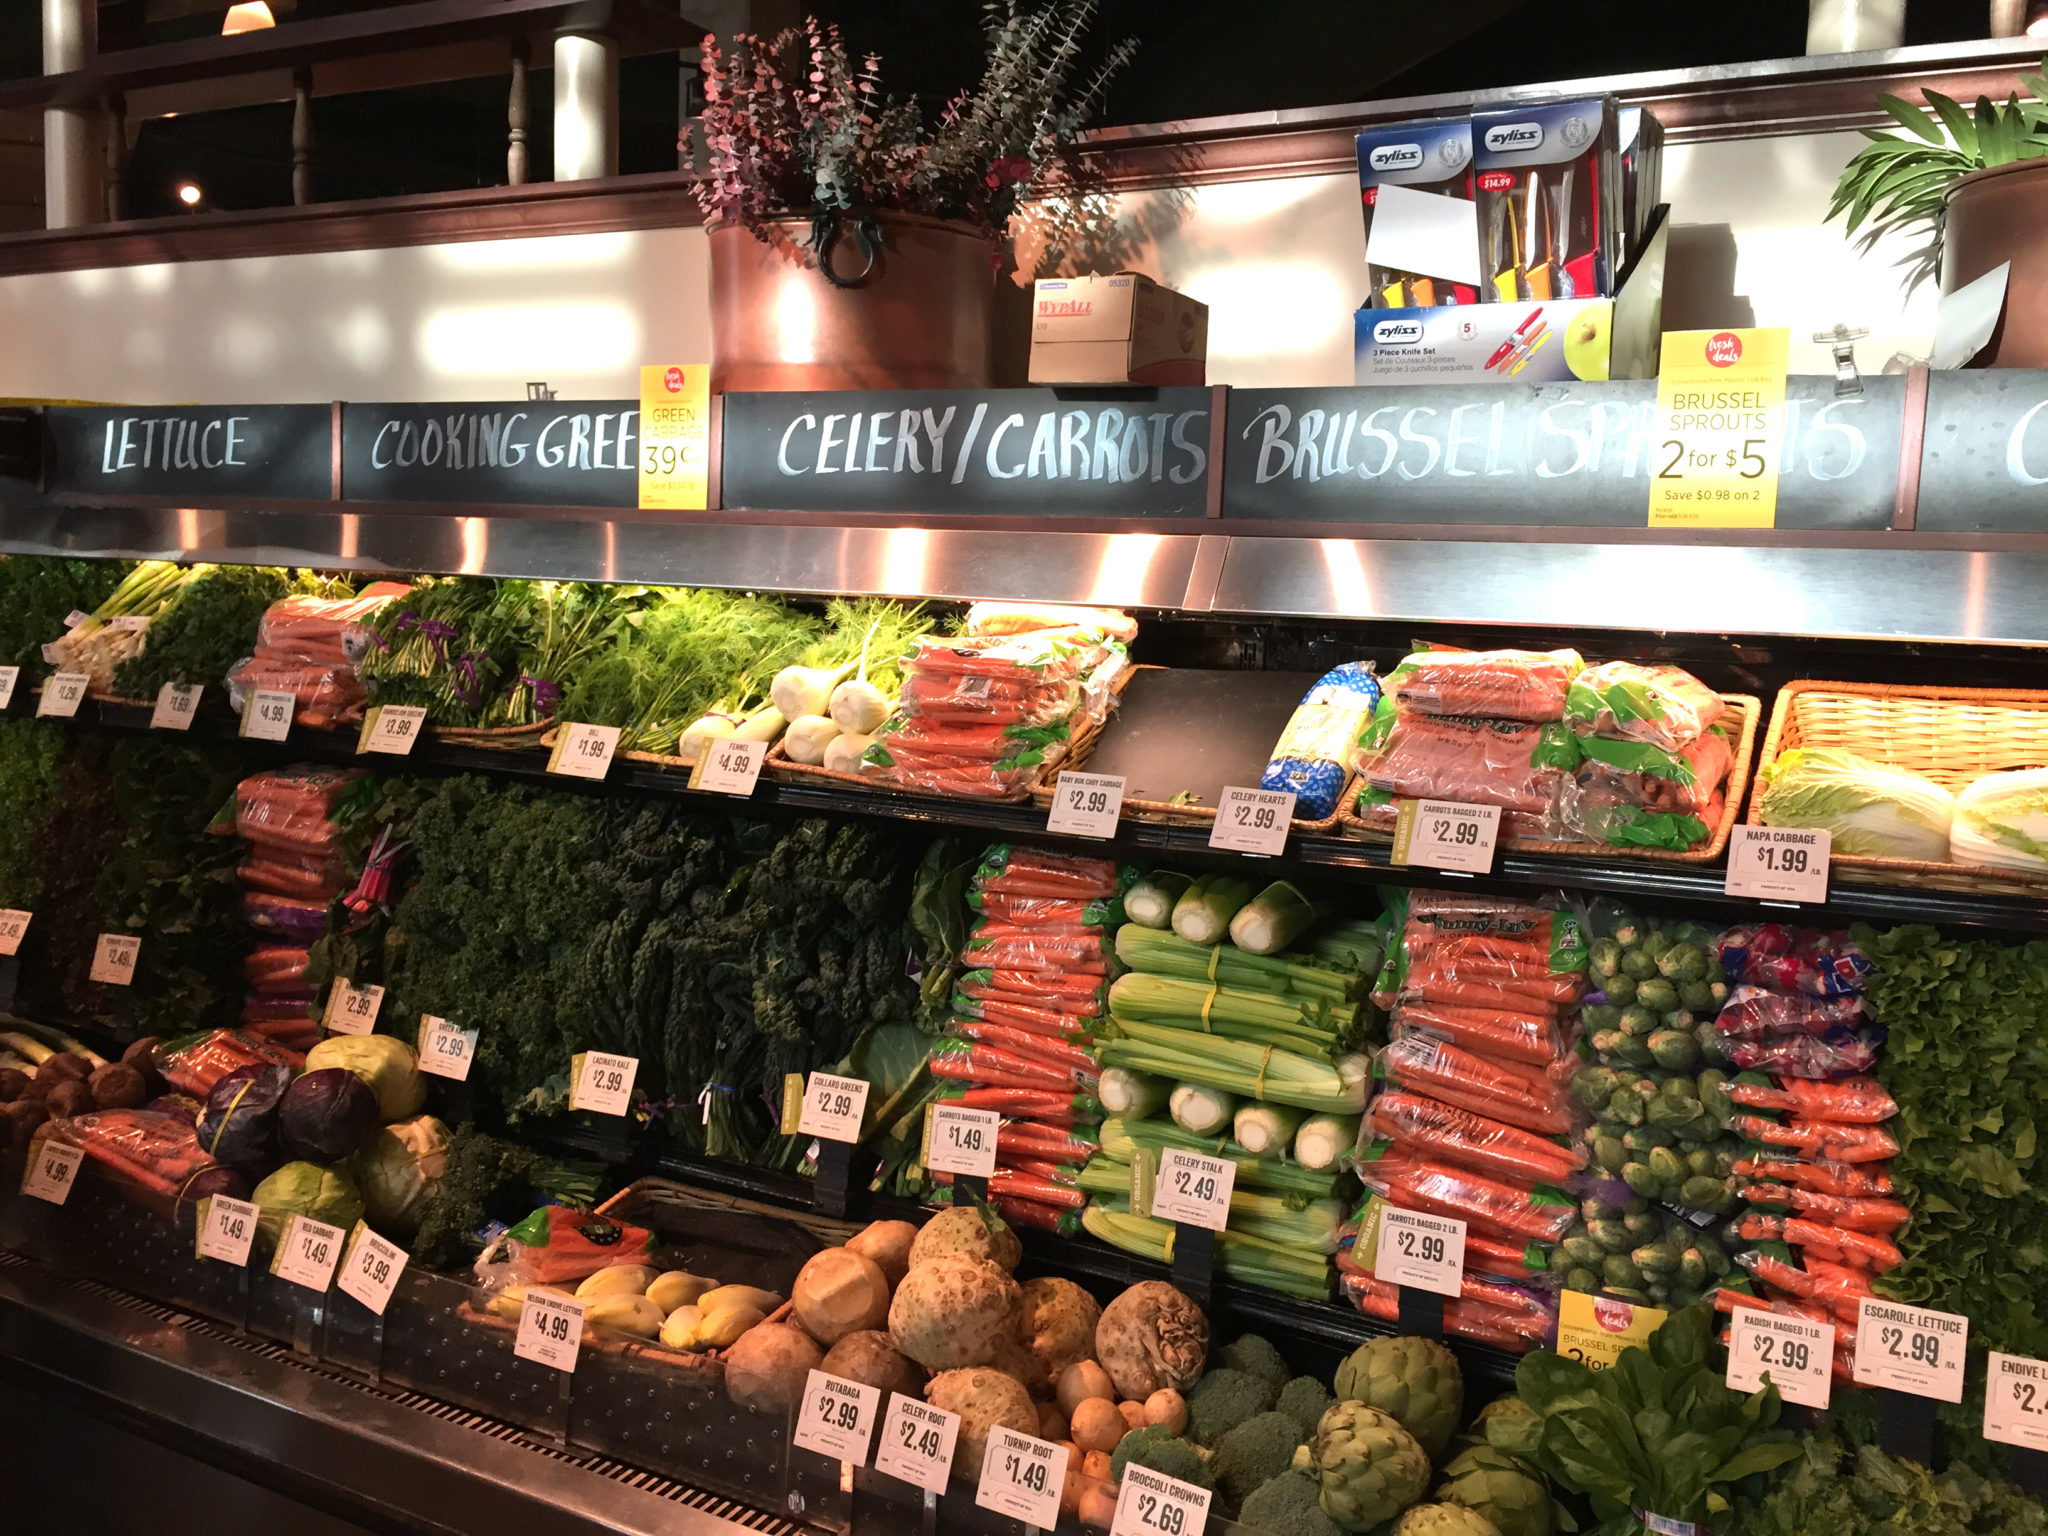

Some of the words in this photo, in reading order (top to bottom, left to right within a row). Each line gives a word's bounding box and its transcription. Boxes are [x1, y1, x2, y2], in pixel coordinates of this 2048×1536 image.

[1490, 129, 1538, 145] zyliss
[1375, 149, 1418, 165] zyliss
[1484, 177, 1511, 189] $14.99
[1109, 278, 1129, 288] 05320
[1378, 326, 1418, 338] zyliss
[1463, 322, 1471, 333] 5
[1709, 337, 1734, 351] fresh
[1713, 351, 1739, 362] deals
[1674, 392, 1766, 410] BRUSSEL
[653, 408, 695, 422] GREEN
[1670, 413, 1766, 430] SPROUTS
[102, 416, 250, 473] LETTUCE
[372, 412, 528, 470] COOKING
[536, 410, 640, 470] GREE
[1243, 402, 1513, 485] BRUSSEL
[1536, 397, 1866, 481] SPRTS
[1658, 440, 1684, 478] 2
[1689, 450, 1717, 467] for
[1725, 439, 1766, 478] $5
[1665, 490, 1692, 500] Save
[1697, 490, 1730, 501] $0.98
[1734, 492, 1749, 500] on
[1753, 490, 1760, 500] 2
[260, 704, 284, 722] $4.99
[386, 718, 411, 736] $3.99
[578, 738, 605, 758] $1.99
[729, 742, 748, 751] FENNEL
[719, 753, 750, 773] $4.99
[1060, 775, 1073, 784] BABY
[1099, 778, 1123, 788] CABBAGE
[1069, 790, 1107, 813] $2.99
[1231, 791, 1257, 803] CELERY
[1258, 794, 1287, 805] HEARTS
[1235, 806, 1275, 830] $2.99
[1423, 805, 1451, 815] CARROTS
[1452, 807, 1476, 817] BAGGED
[1477, 809, 1482, 817] 2
[1433, 820, 1478, 845] $2.99
[1746, 831, 1771, 841] NAPA
[1773, 833, 1816, 844] CABBAGE
[1757, 846, 1808, 873] $1.99
[346, 995, 371, 1016] $2.99
[436, 1034, 464, 1057] $2.99
[592, 1056, 616, 1067] LACINATO
[617, 1060, 630, 1070] KALE
[593, 1069, 623, 1092] $2.99
[814, 1076, 840, 1089] COLLARD
[840, 1081, 863, 1094] GREENS
[818, 1091, 851, 1116] $2.99
[939, 1111, 961, 1121] CARROTS
[962, 1114, 982, 1123] BAGGED
[949, 1126, 982, 1150] $1.49
[1174, 1155, 1201, 1169] CELERY
[1201, 1161, 1223, 1174] STALK
[1133, 1163, 1141, 1201] ORGANIC
[1175, 1171, 1215, 1201] $2.49
[216, 1199, 231, 1211] GREEN
[231, 1202, 253, 1216] CABBAGE
[220, 1214, 244, 1239] $1.49
[302, 1222, 313, 1233] RED
[312, 1225, 335, 1240] CABBAGE
[1360, 1212, 1377, 1250] ORGANIC
[1387, 1212, 1415, 1226] CARROTS
[1416, 1218, 1441, 1231] BAGGED
[1442, 1224, 1448, 1233] 2
[302, 1237, 328, 1264] $1.49
[1398, 1230, 1445, 1263] $2.99
[362, 1252, 390, 1284] $3.99
[563, 1303, 583, 1317] LETTUCE
[1864, 1304, 1915, 1324] ESCAROLE
[1918, 1315, 1962, 1334] LETTUCE
[535, 1310, 569, 1341] $4.99
[1601, 1313, 1629, 1329] deals
[1744, 1315, 1772, 1330] RADISH
[1773, 1321, 1803, 1336] BAGGED
[1805, 1327, 1808, 1337] 1
[1563, 1334, 1607, 1351] BRUSSEL
[1753, 1334, 1809, 1371] $2.99
[1881, 1326, 1940, 1366] $2.99
[1585, 1355, 1609, 1371] for
[2001, 1360, 2039, 1378] ENDIVE
[825, 1379, 861, 1400] RUTABAGA
[819, 1395, 859, 1431] $2.99
[902, 1402, 927, 1420] CELERY
[928, 1410, 947, 1427] ROOT
[900, 1420, 940, 1458] $2.49
[1003, 1434, 1032, 1452] TURNIP
[1032, 1442, 1054, 1460] ROOT
[1005, 1454, 1046, 1492] $1.49
[1128, 1469, 1167, 1494] BROCCOLI
[1168, 1483, 1206, 1508] CROWNS
[1137, 1493, 1185, 1536] $2.69
